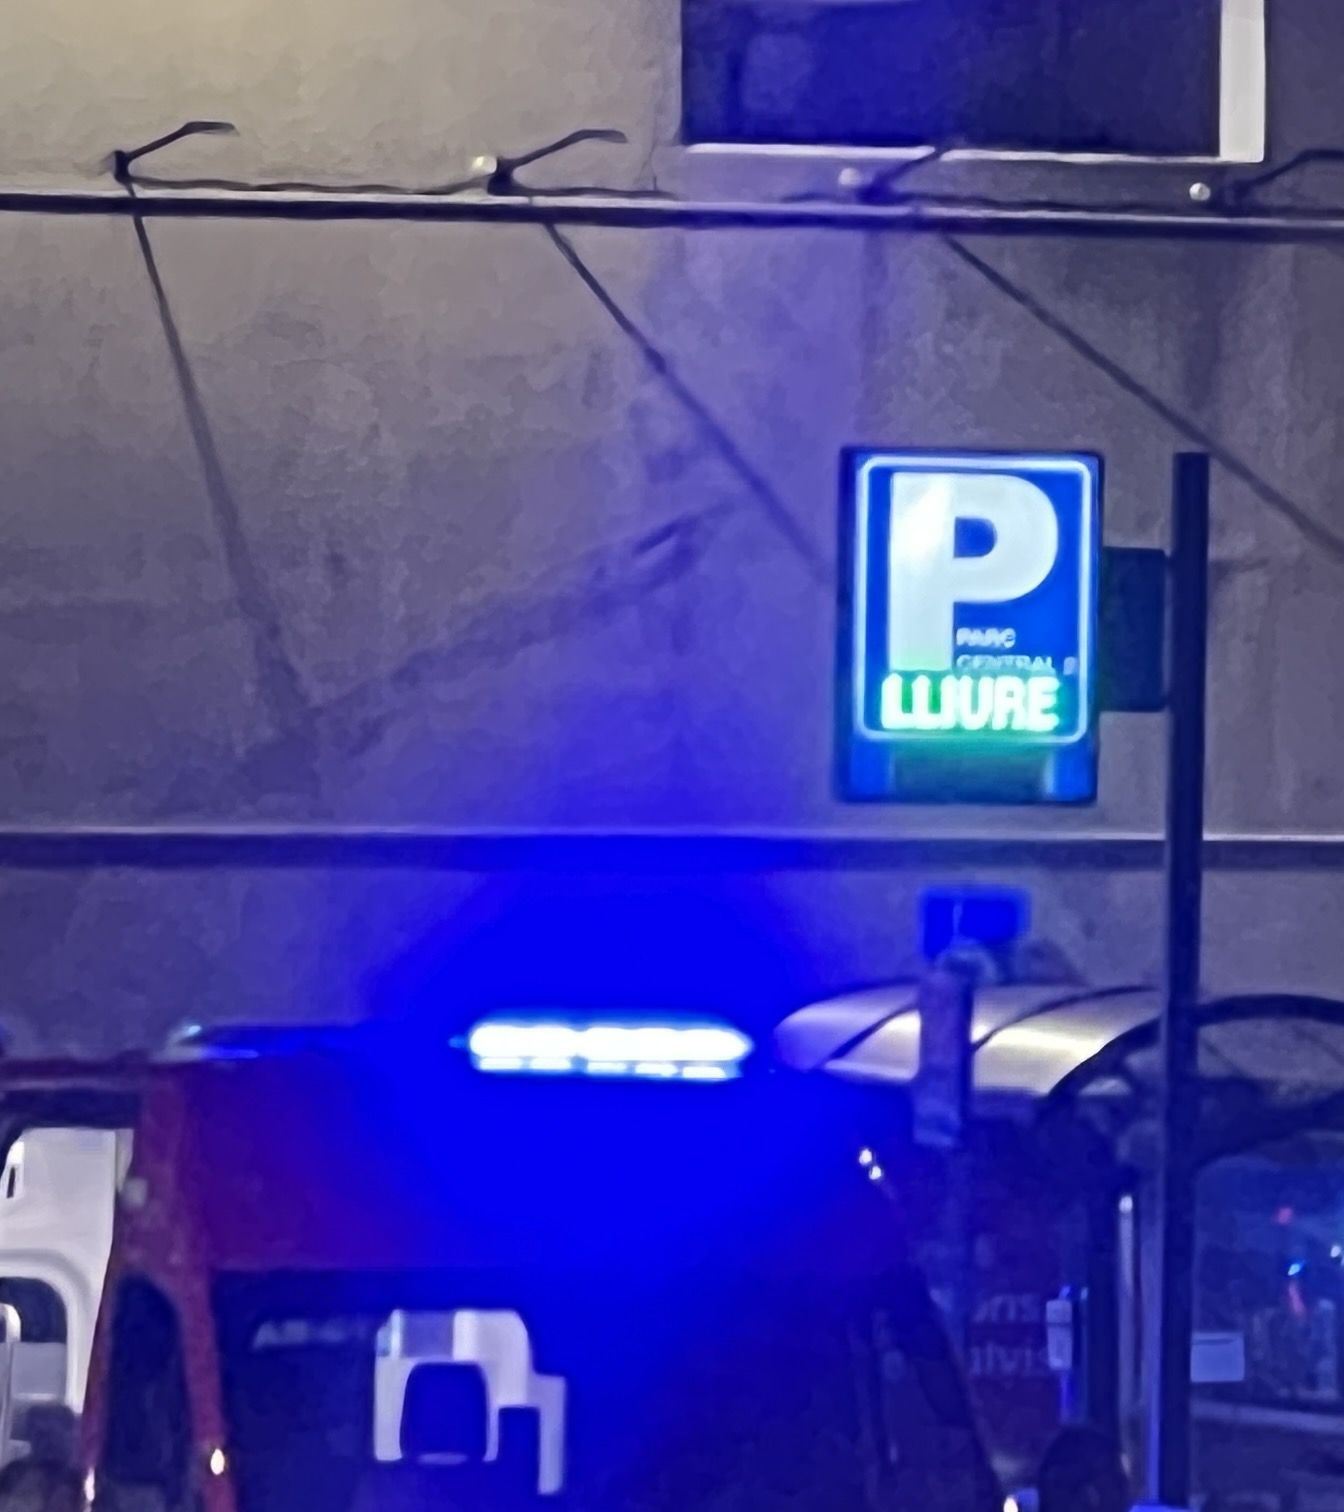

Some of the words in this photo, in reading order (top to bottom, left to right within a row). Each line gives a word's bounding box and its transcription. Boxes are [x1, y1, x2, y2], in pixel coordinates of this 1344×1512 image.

[889, 472, 1058, 671] P
[956, 627, 1017, 648] PARC
[957, 654, 1056, 675] CENTRAL
